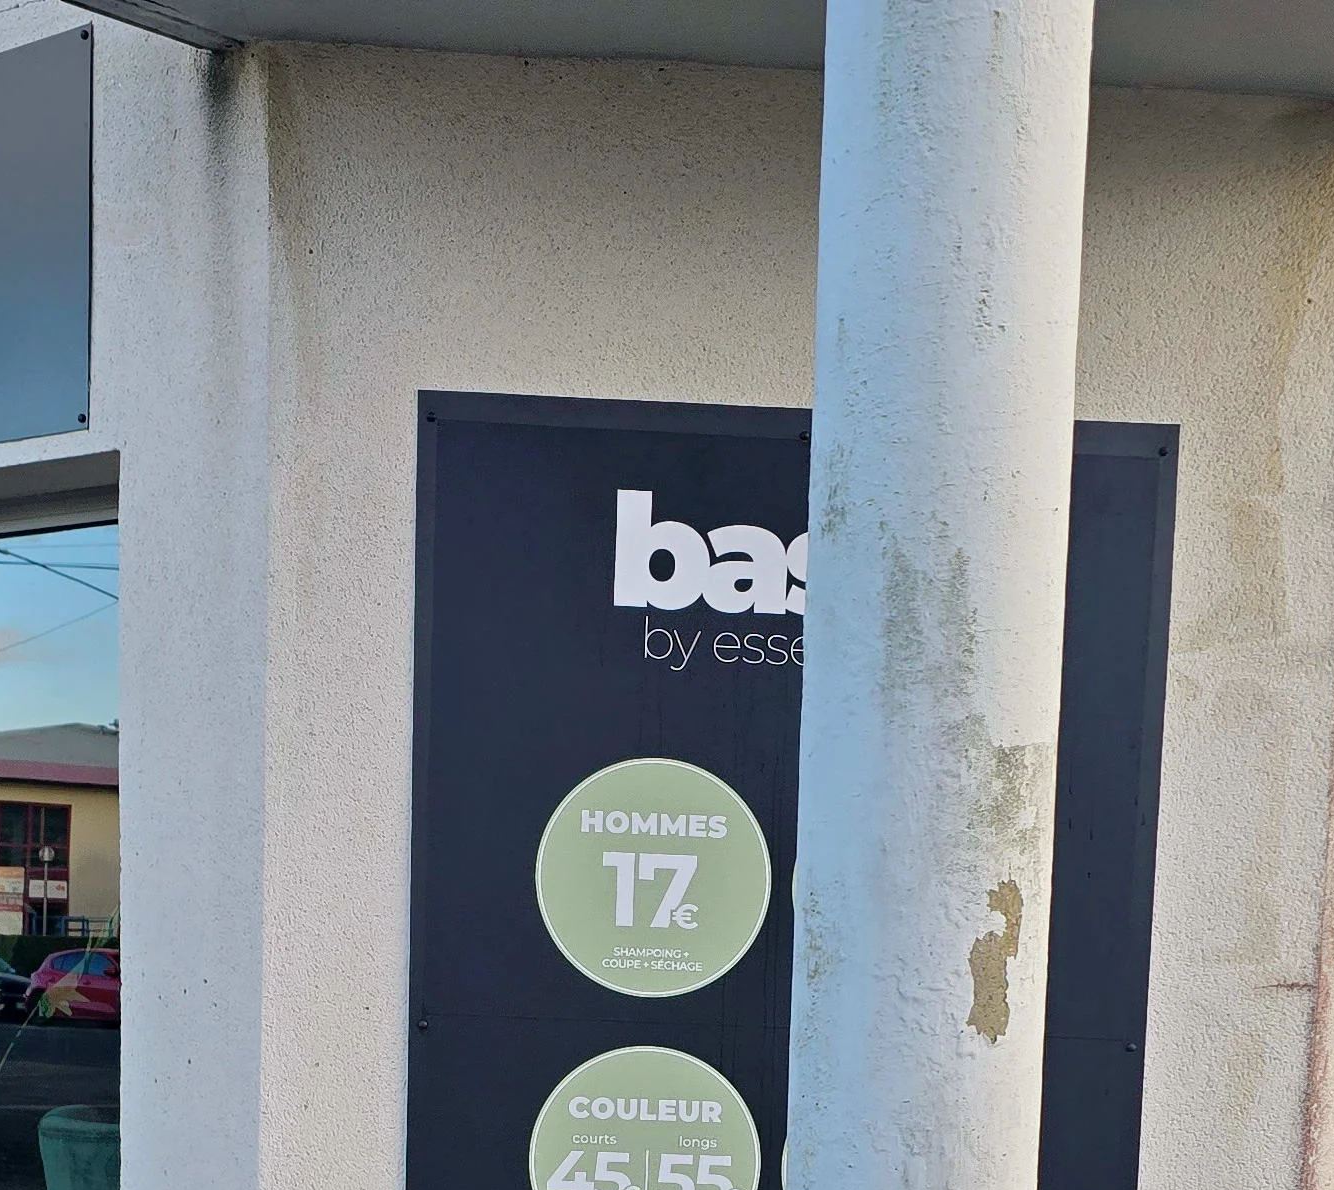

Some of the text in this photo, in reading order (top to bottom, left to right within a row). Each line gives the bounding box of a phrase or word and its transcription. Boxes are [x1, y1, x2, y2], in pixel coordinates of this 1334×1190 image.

[644, 615, 701, 671] by
[580, 809, 728, 839] HOMMES
[602, 851, 700, 930] 17€
[601, 958, 641, 969] COUPE
[650, 959, 703, 973] SÉCHAGE
[612, 946, 682, 959] SHAMPOING
[568, 1096, 723, 1124] COULEUR
[572, 1133, 717, 1150] courts longs
